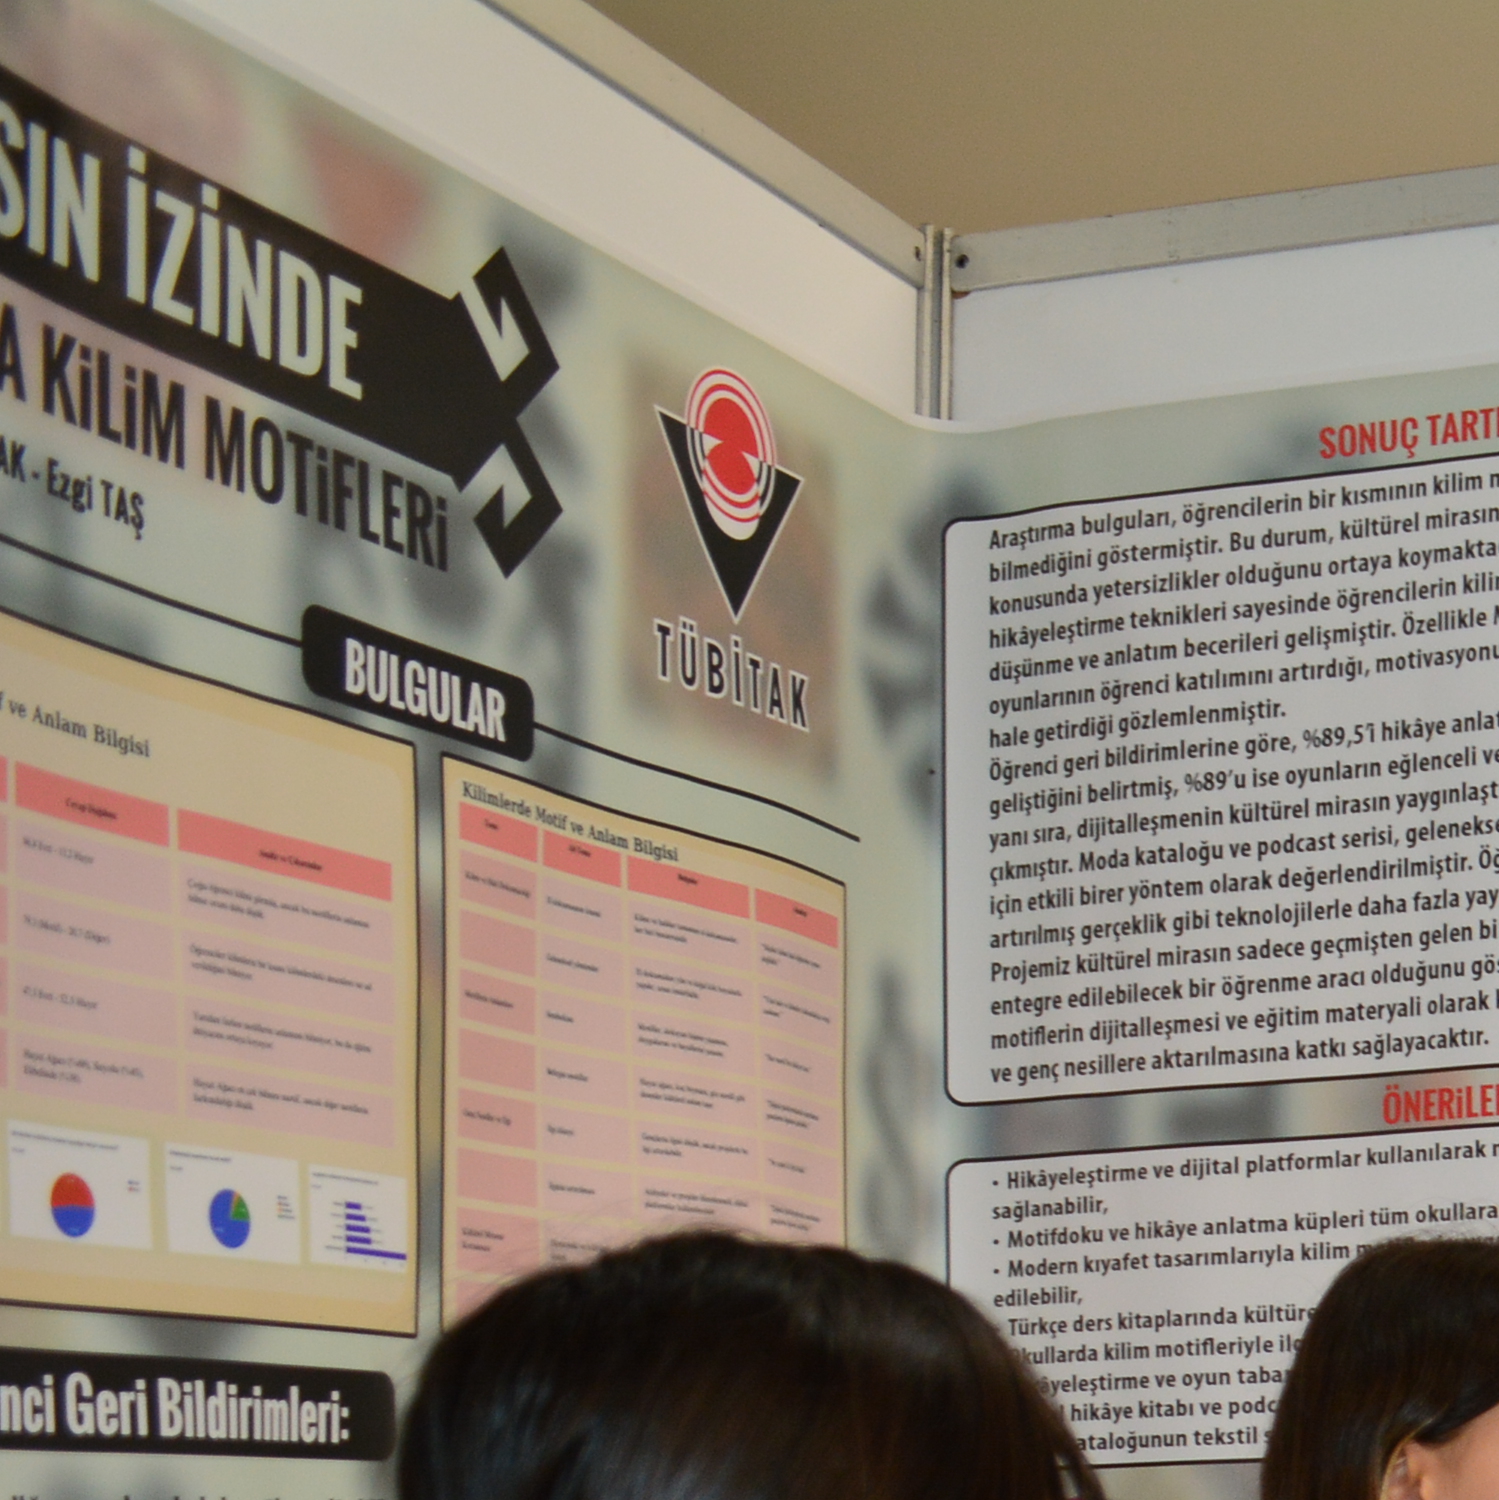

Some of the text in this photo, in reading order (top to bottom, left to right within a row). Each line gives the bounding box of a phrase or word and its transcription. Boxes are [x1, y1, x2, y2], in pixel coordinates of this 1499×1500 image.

[126, 145, 362, 400] İZİNDE
[1319, 418, 1418, 459] SONUÇ
[46, 458, 144, 540] Ezgi TAŞ
[345, 638, 505, 742] BULGULAR
[654, 619, 810, 733] TÜBİTAK
[990, 701, 1285, 748] hale getirdiği gözlemlenmiştir.
[464, 782, 677, 860] Kilimlerde Motif ve Anlam Bilgisi
[991, 1028, 1488, 1086] ve genç nesillere aktarılmasına katkı sağlayacaktır.
[65, 1372, 349, 1444] Geri Bildirimleri:
